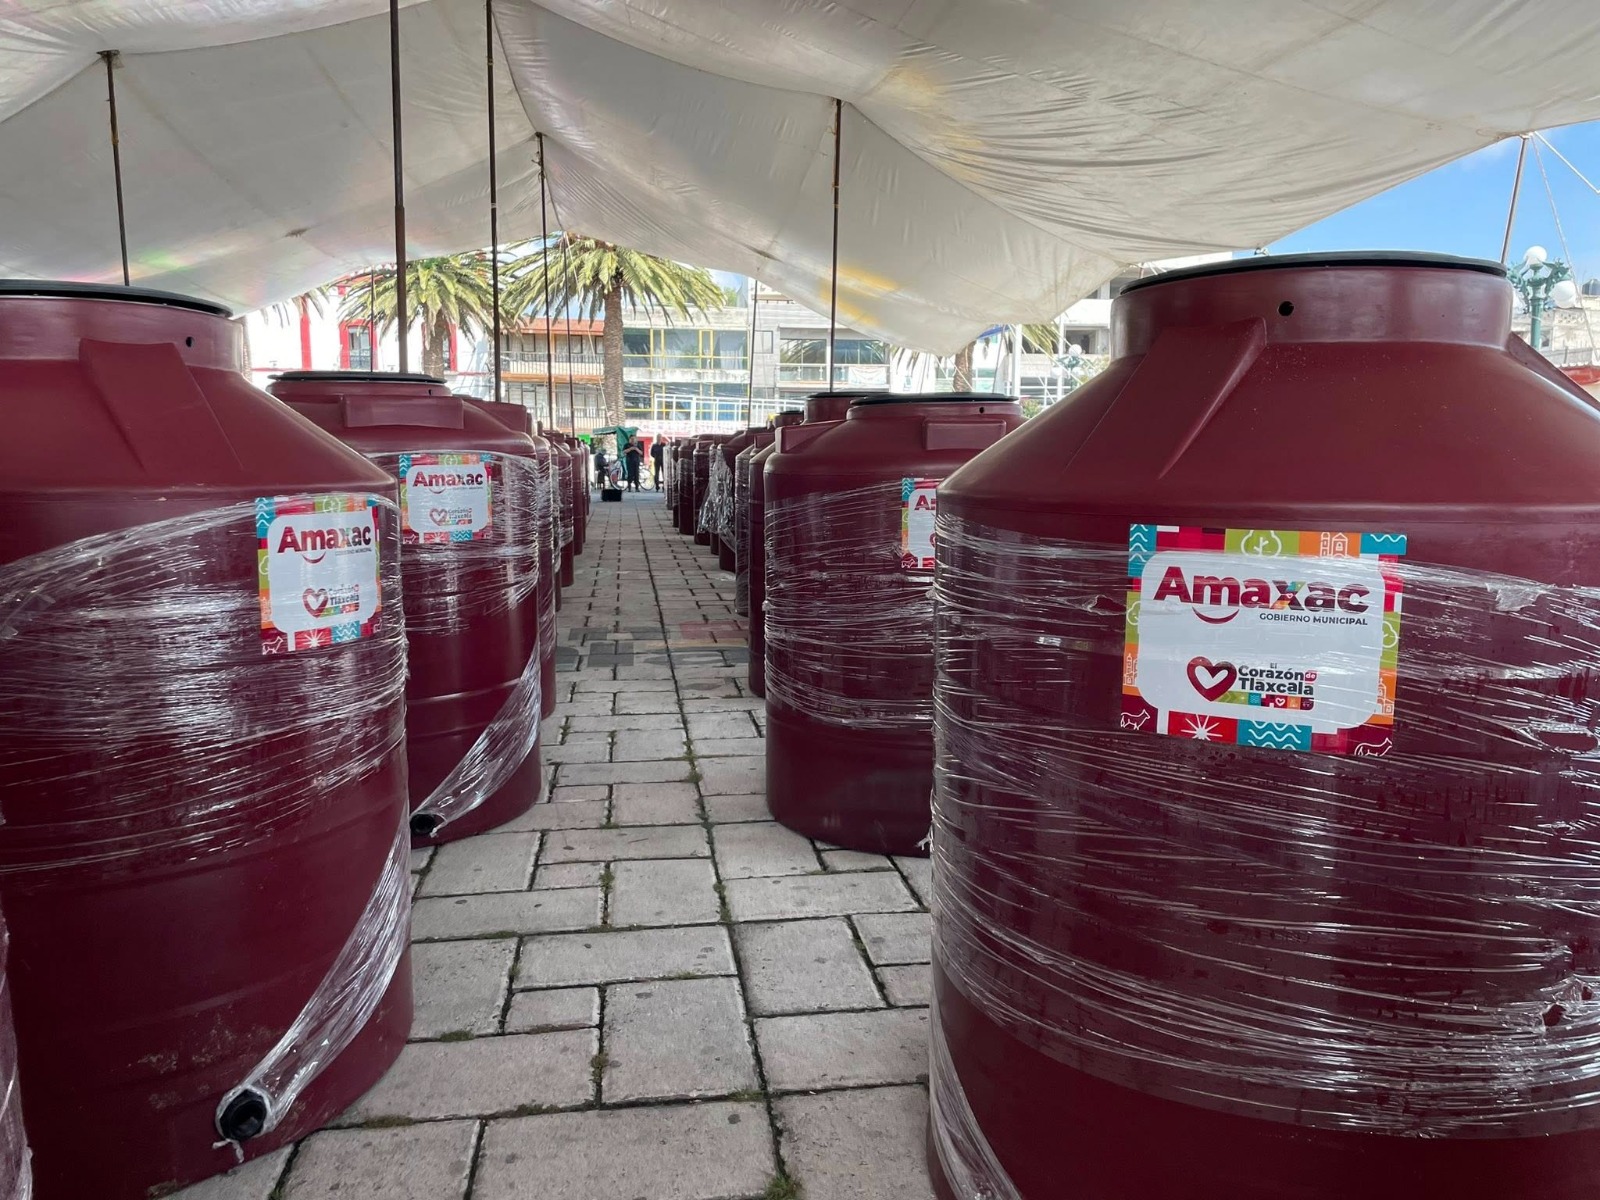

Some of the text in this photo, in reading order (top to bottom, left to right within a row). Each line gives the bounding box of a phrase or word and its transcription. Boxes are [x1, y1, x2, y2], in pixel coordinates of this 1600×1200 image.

[413, 471, 483, 487] Amaxac
[277, 526, 371, 553] Amaxac
[1153, 566, 1370, 613] Amaxac
[1259, 612, 1368, 625] GOBIERNO MUNICIPAL
[1238, 665, 1316, 681] Corazón de
[1238, 677, 1314, 696] Tlaxcala
